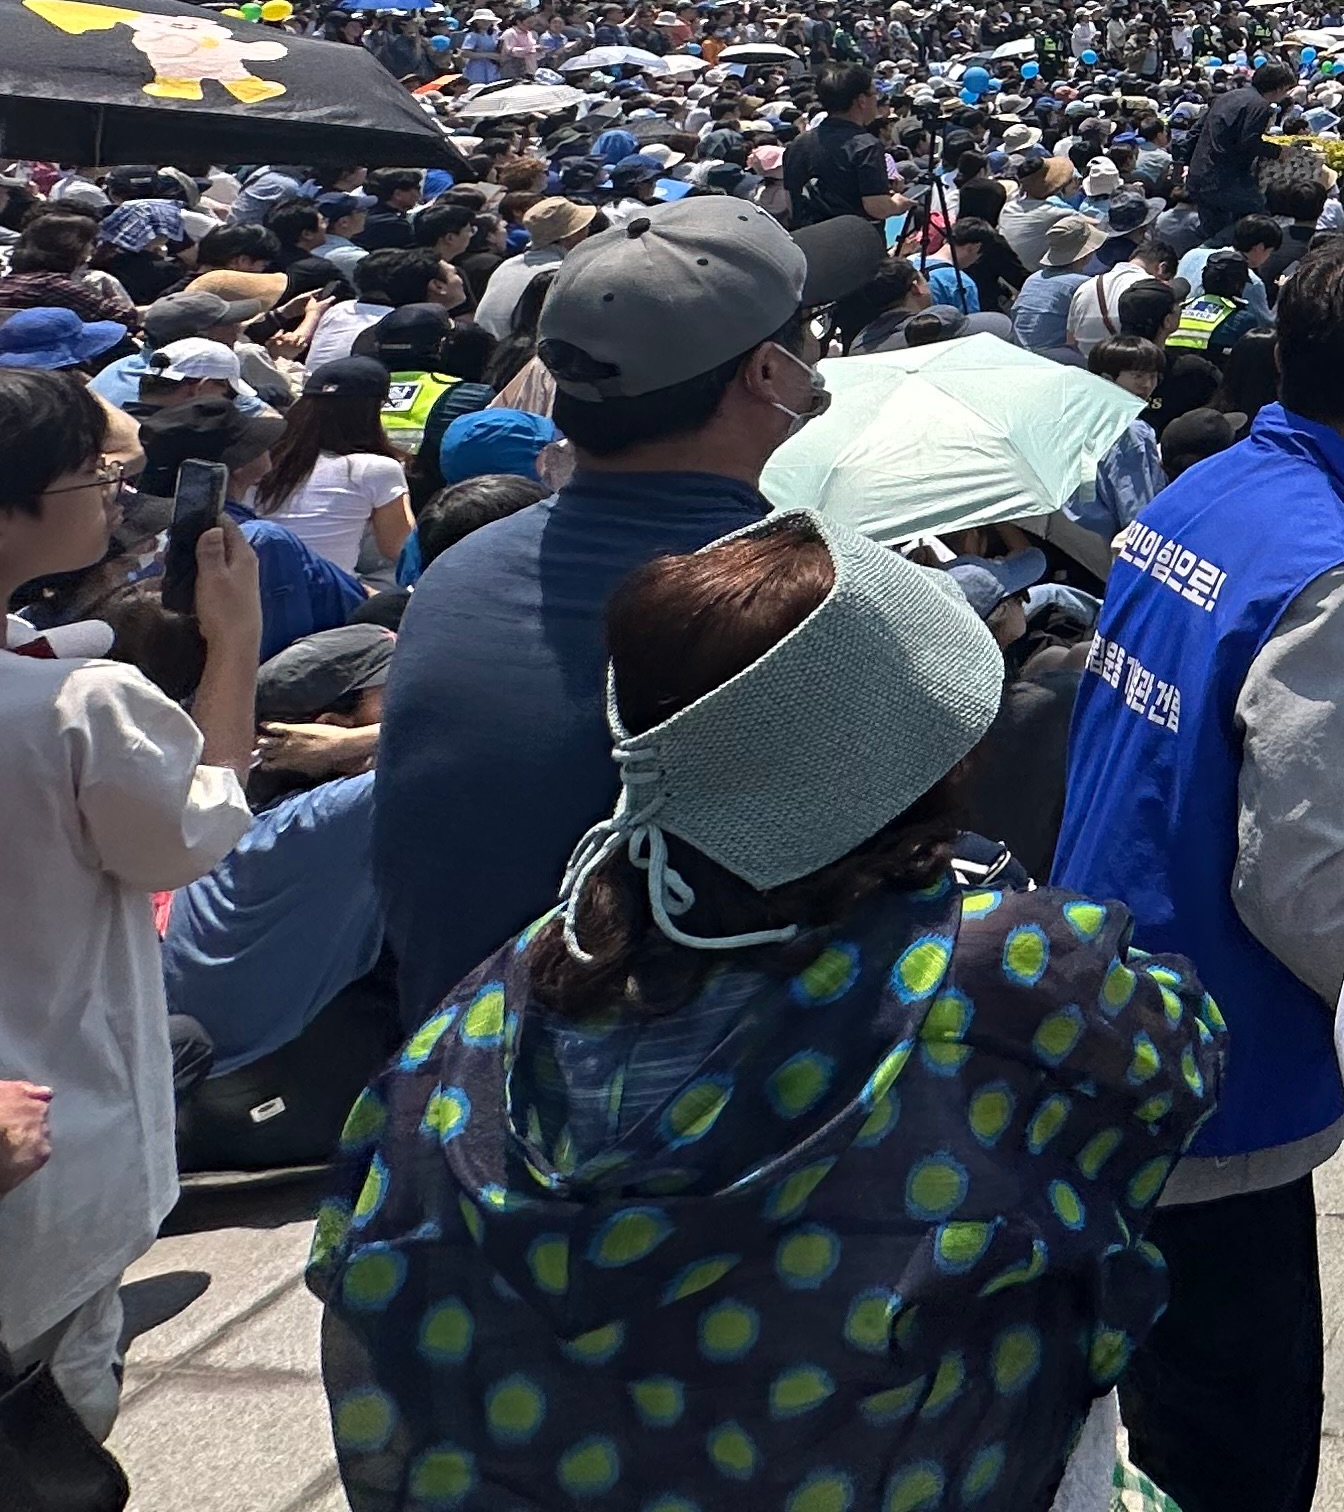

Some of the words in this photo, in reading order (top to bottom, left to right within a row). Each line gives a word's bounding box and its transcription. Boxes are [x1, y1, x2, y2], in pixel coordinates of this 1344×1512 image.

[1150, 540, 1228, 612] 힘으로!
[1085, 629, 1127, 689] 립운동
[1124, 656, 1155, 715] 기념관
[1148, 679, 1181, 733] 건립
